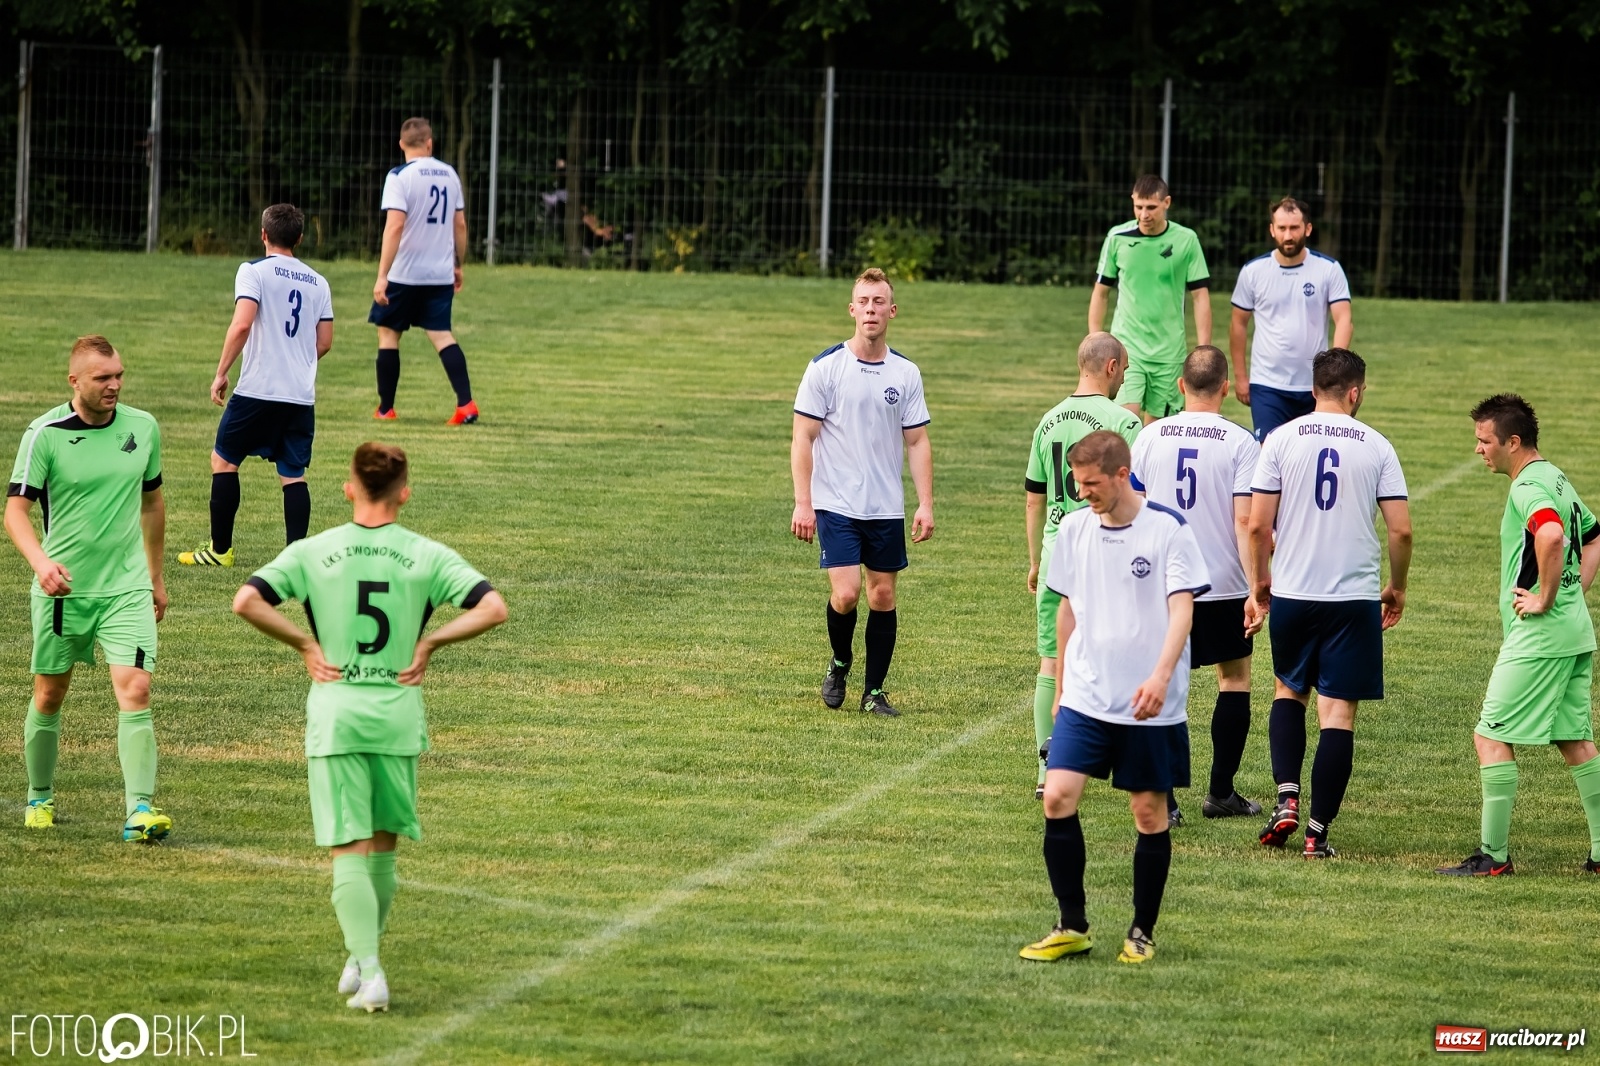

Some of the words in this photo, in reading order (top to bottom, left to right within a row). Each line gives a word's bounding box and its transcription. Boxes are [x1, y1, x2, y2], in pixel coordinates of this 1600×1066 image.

[427, 184, 448, 225] 21
[274, 266, 290, 279] OCICE
[291, 270, 318, 286] RACIBÓRZ
[285, 289, 302, 338] 3
[1042, 419, 1055, 435] LKS
[1160, 425, 1184, 437] OCICE
[1185, 425, 1228, 441] RACIBÓRZ
[1298, 423, 1323, 436] OCICE
[1324, 425, 1366, 442] RACIBÓRZ
[1175, 447, 1199, 510] 5
[1314, 447, 1340, 511] 6
[321, 551, 342, 568] LKS
[343, 545, 415, 570] ZWONOWICE
[356, 580, 390, 655] 5
